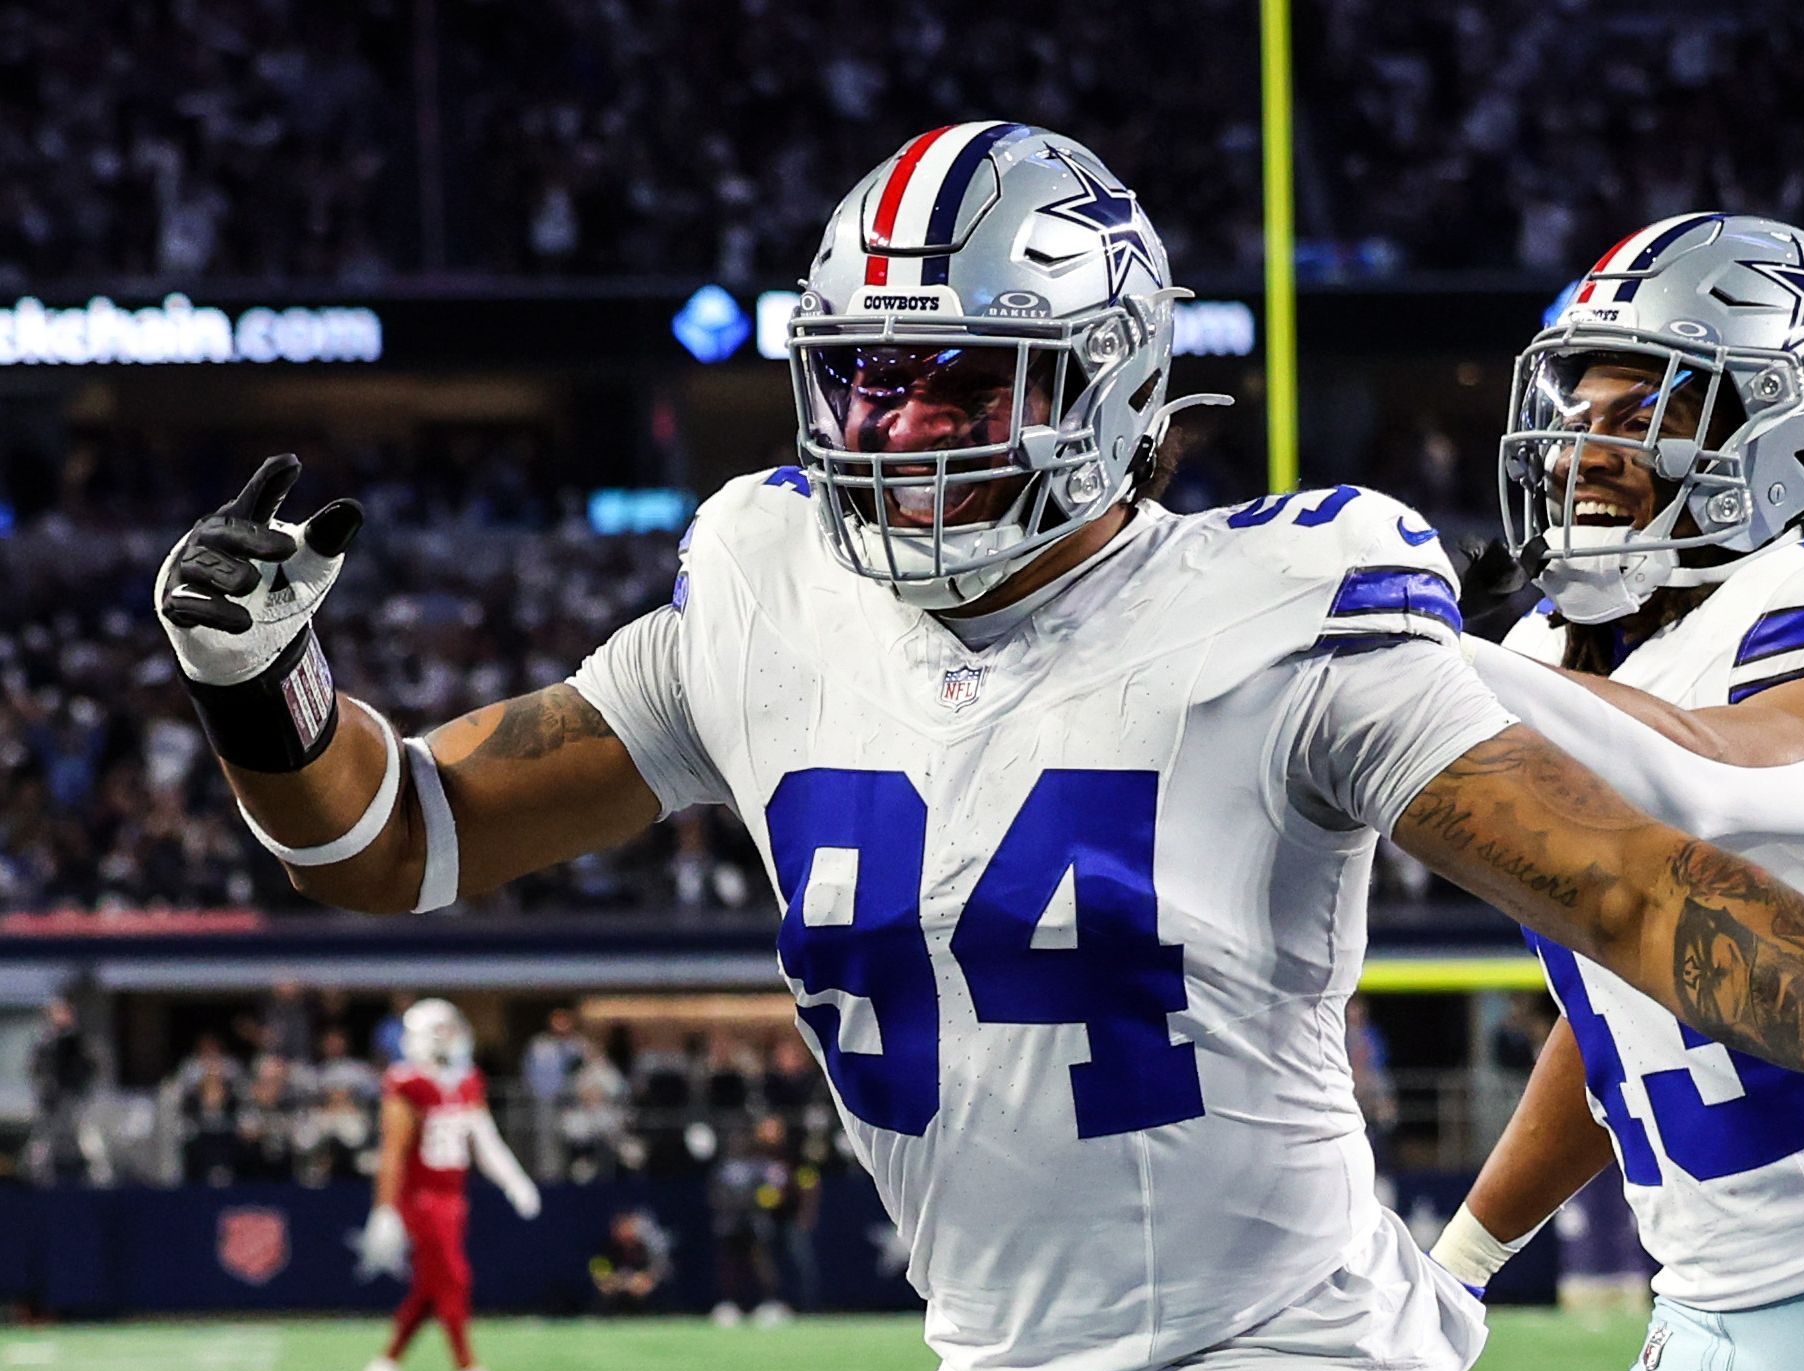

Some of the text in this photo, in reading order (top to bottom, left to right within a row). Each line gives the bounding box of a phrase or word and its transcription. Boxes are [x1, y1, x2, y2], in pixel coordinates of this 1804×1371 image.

[864, 296, 940, 311] COWBOYS
[989, 307, 1047, 318] OAKLEY
[944, 682, 973, 701] NFL
[766, 768, 1206, 1140] 94
